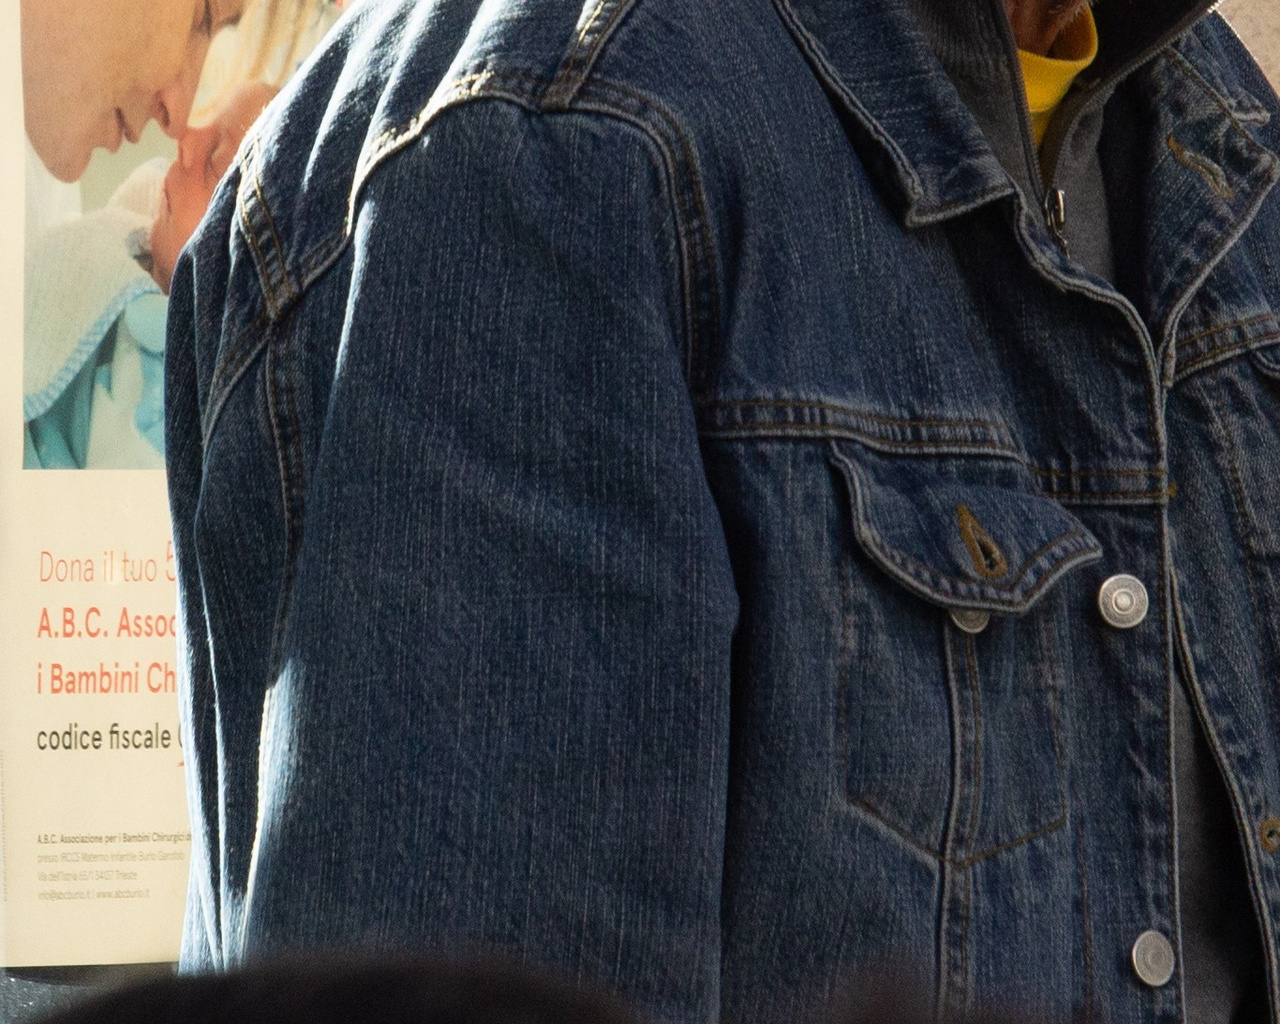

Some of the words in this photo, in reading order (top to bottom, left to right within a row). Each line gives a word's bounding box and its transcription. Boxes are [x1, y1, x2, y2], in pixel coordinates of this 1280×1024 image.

[40, 551, 94, 582] Dona
[103, 550, 113, 582] il
[122, 550, 157, 582] tuo
[37, 607, 108, 638] A.B.C.
[37, 662, 42, 694] i
[50, 663, 139, 694] Bambini
[37, 723, 102, 750] codice
[109, 722, 171, 750] fiscale
